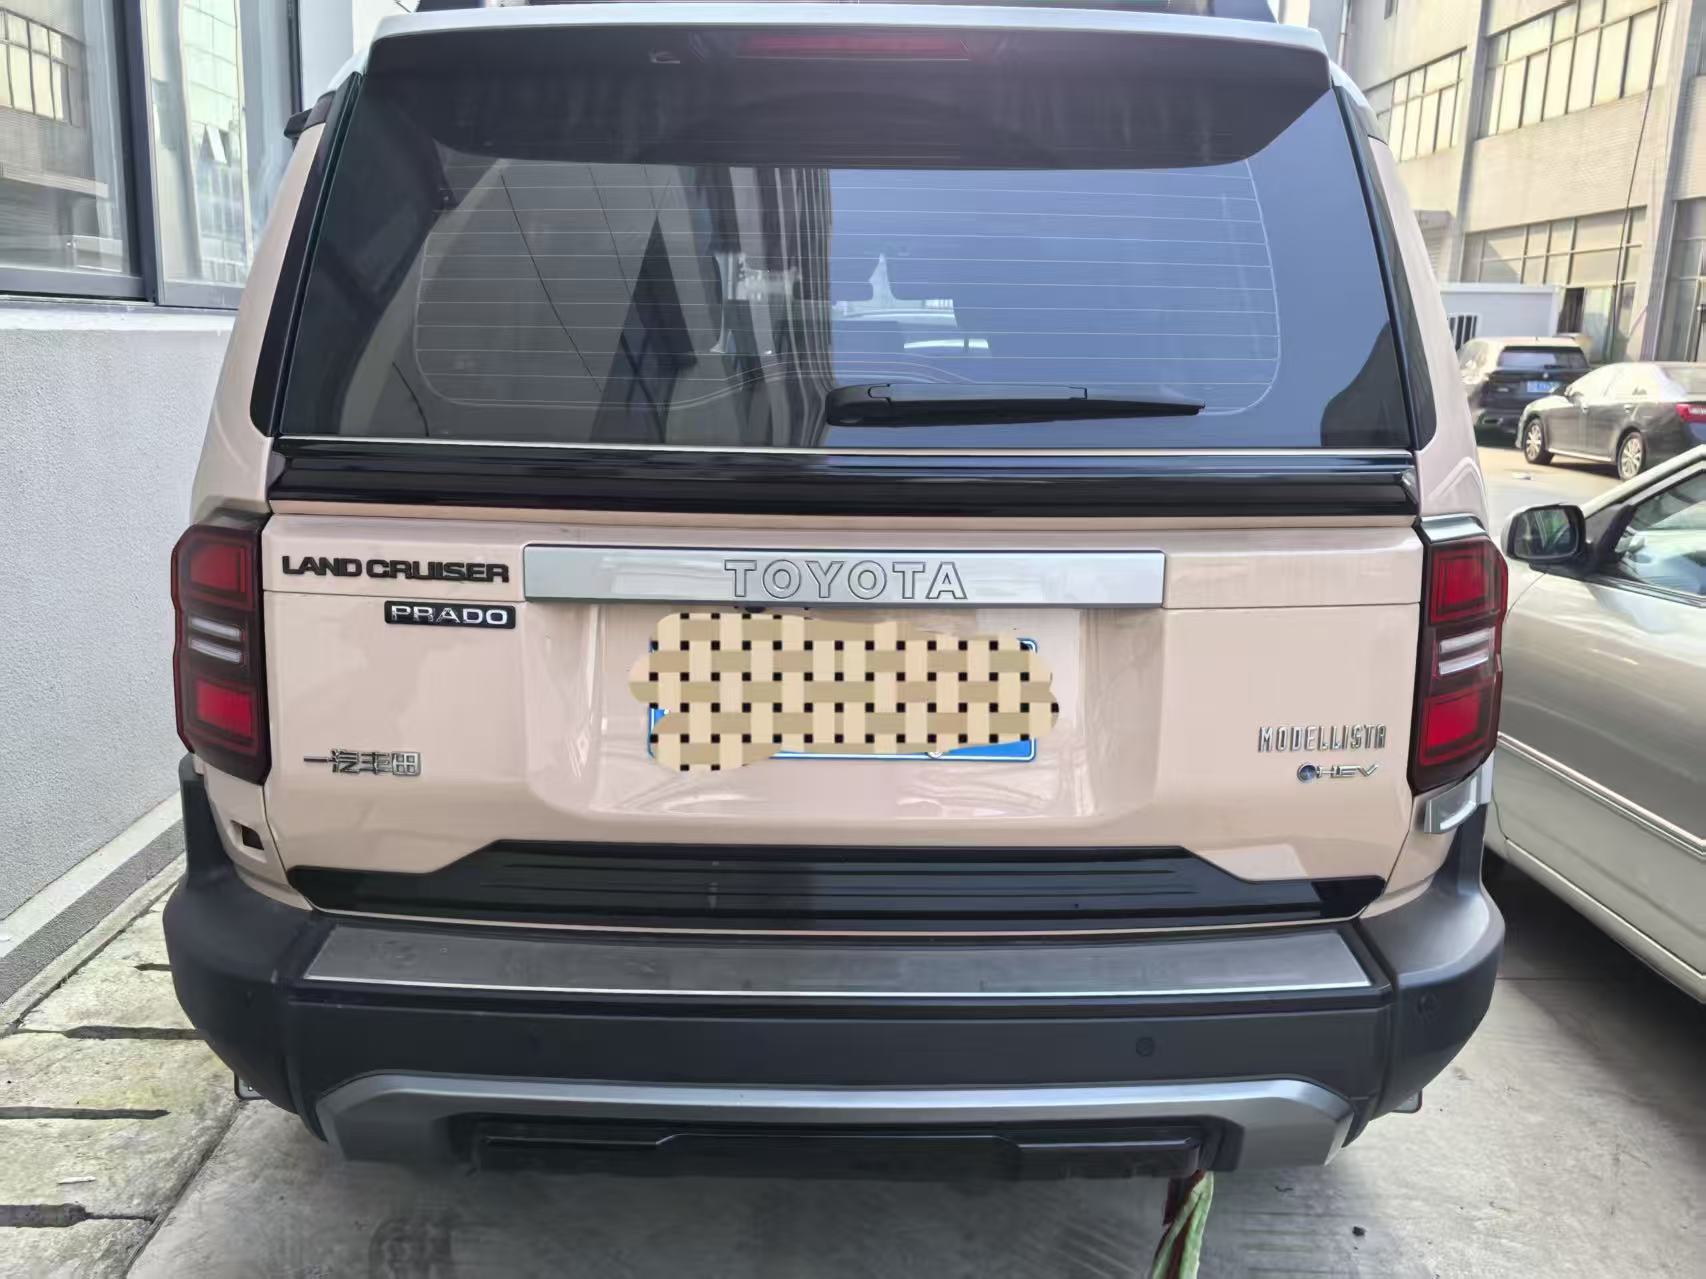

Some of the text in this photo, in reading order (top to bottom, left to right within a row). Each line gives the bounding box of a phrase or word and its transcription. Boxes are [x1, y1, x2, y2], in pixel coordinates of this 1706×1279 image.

[282, 556, 509, 583] LAND CRUISER
[724, 559, 968, 600] TOYOTA
[391, 605, 508, 625] PRADO
[1257, 723, 1387, 753] MODELLISTA
[303, 748, 422, 776] 一汽丰田
[1316, 762, 1379, 778] HEV
